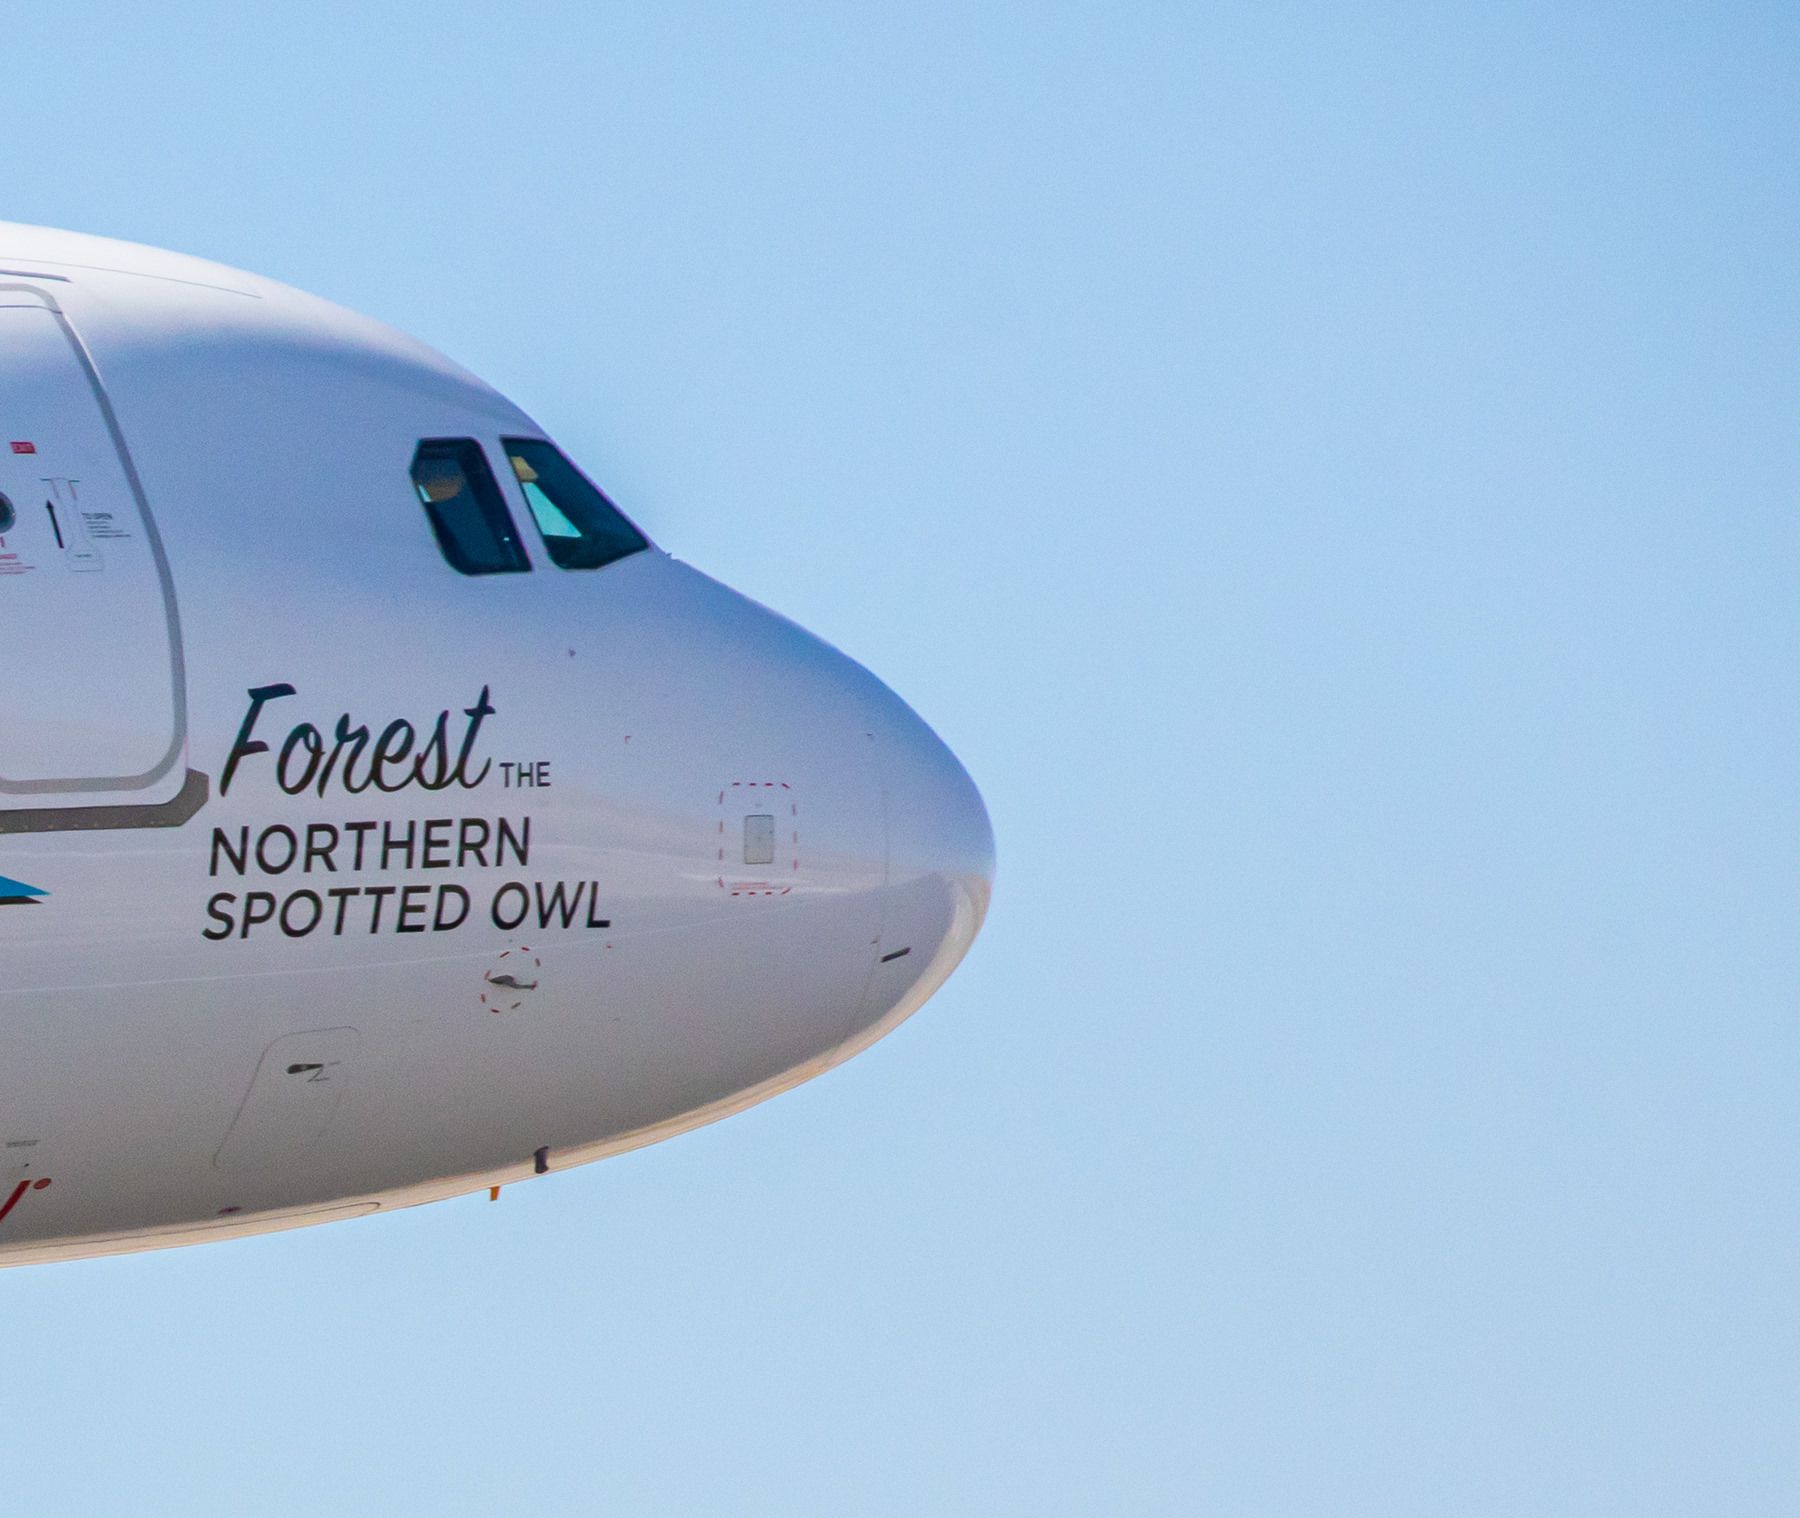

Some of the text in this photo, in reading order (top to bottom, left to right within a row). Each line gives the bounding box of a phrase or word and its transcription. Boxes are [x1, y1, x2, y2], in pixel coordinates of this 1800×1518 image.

[220, 683, 551, 798] Forest THE
[209, 816, 530, 876] NORTHERN
[202, 881, 610, 940] SPOTTED OWL
